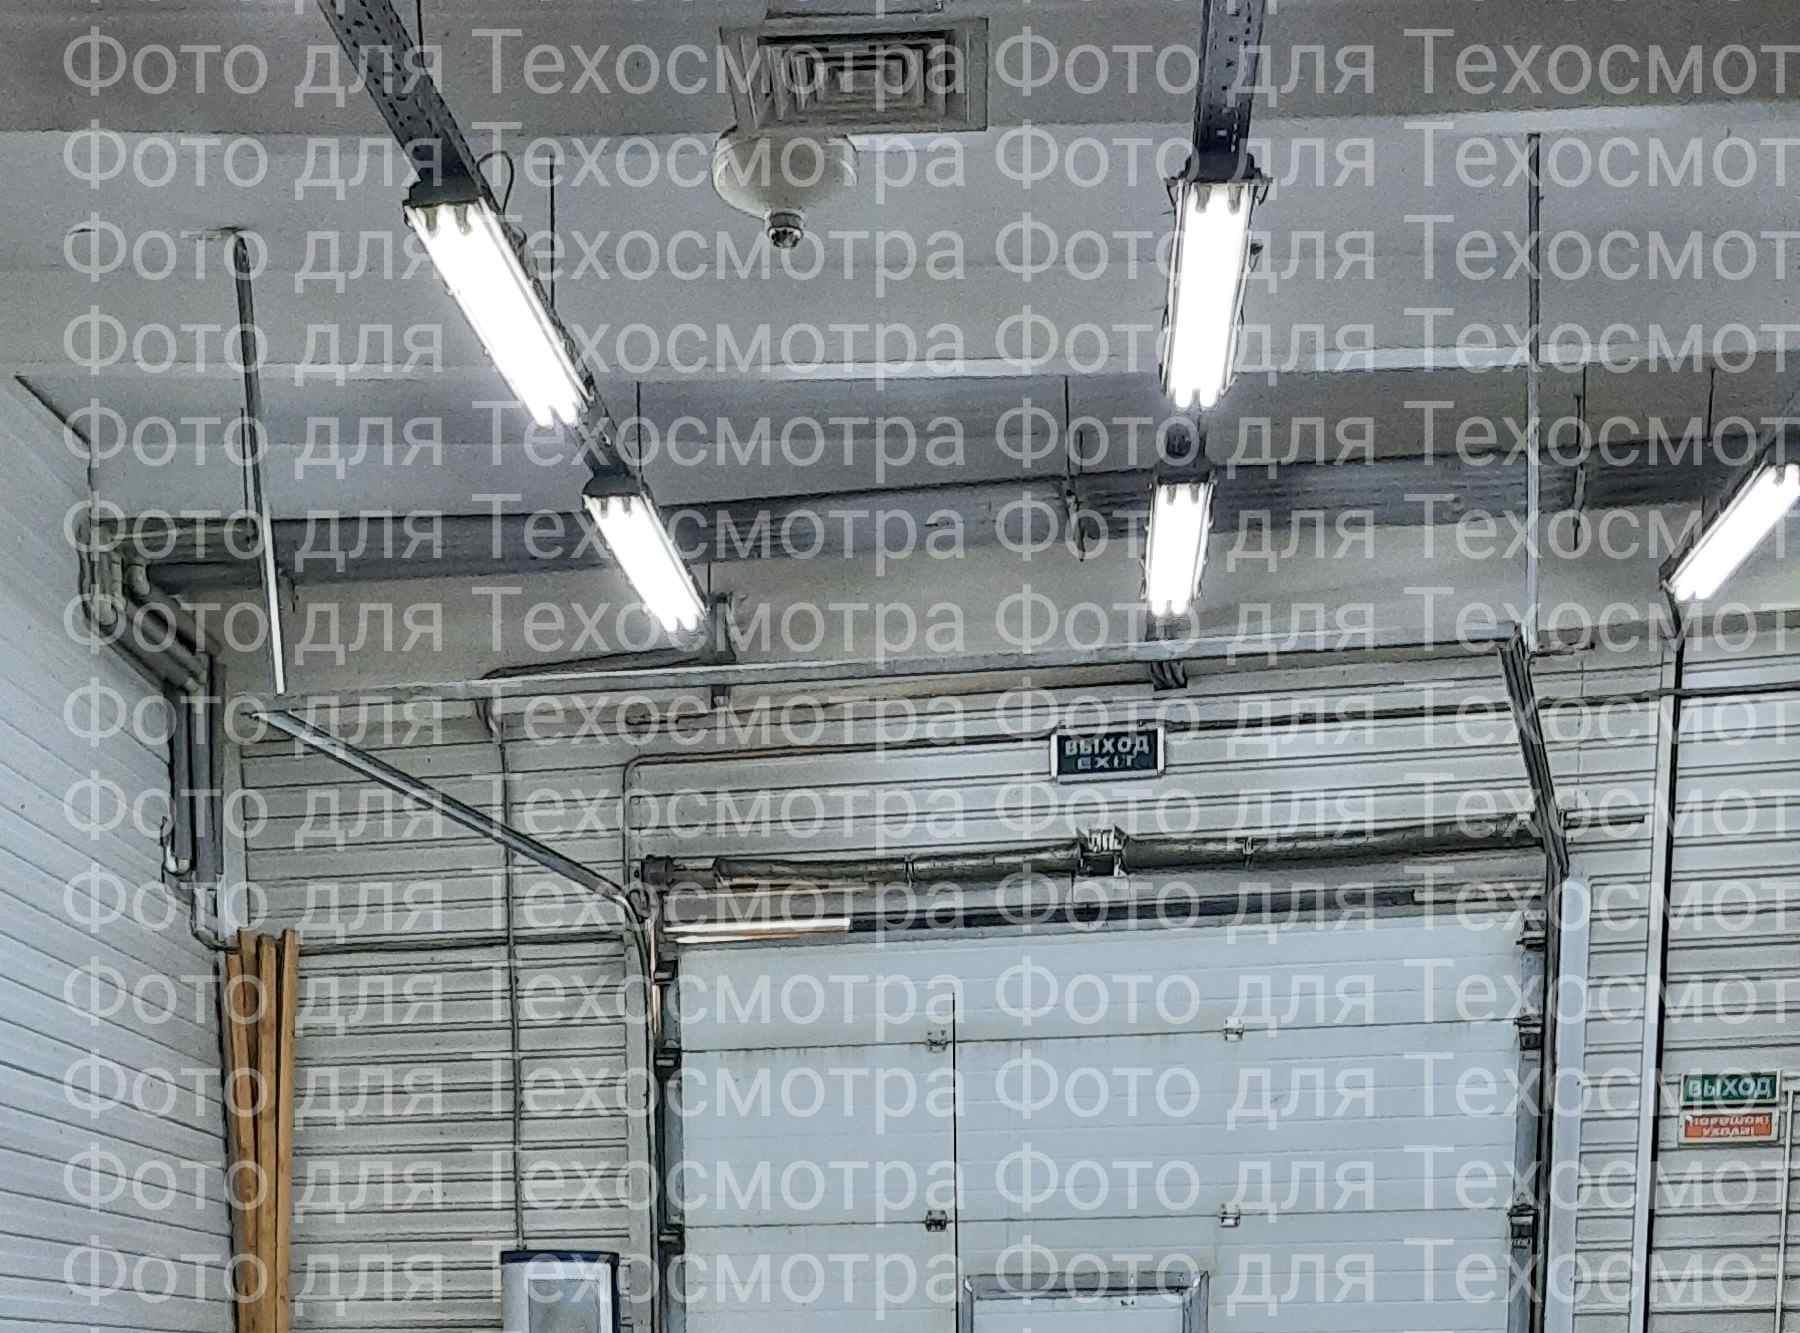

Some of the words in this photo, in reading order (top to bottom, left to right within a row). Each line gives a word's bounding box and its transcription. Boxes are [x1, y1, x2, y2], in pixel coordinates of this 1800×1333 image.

[1065, 736, 1149, 756] ВЫХОД
[1077, 754, 1136, 769] EXIT
[1688, 1078, 1772, 1099] ВЫХОД
